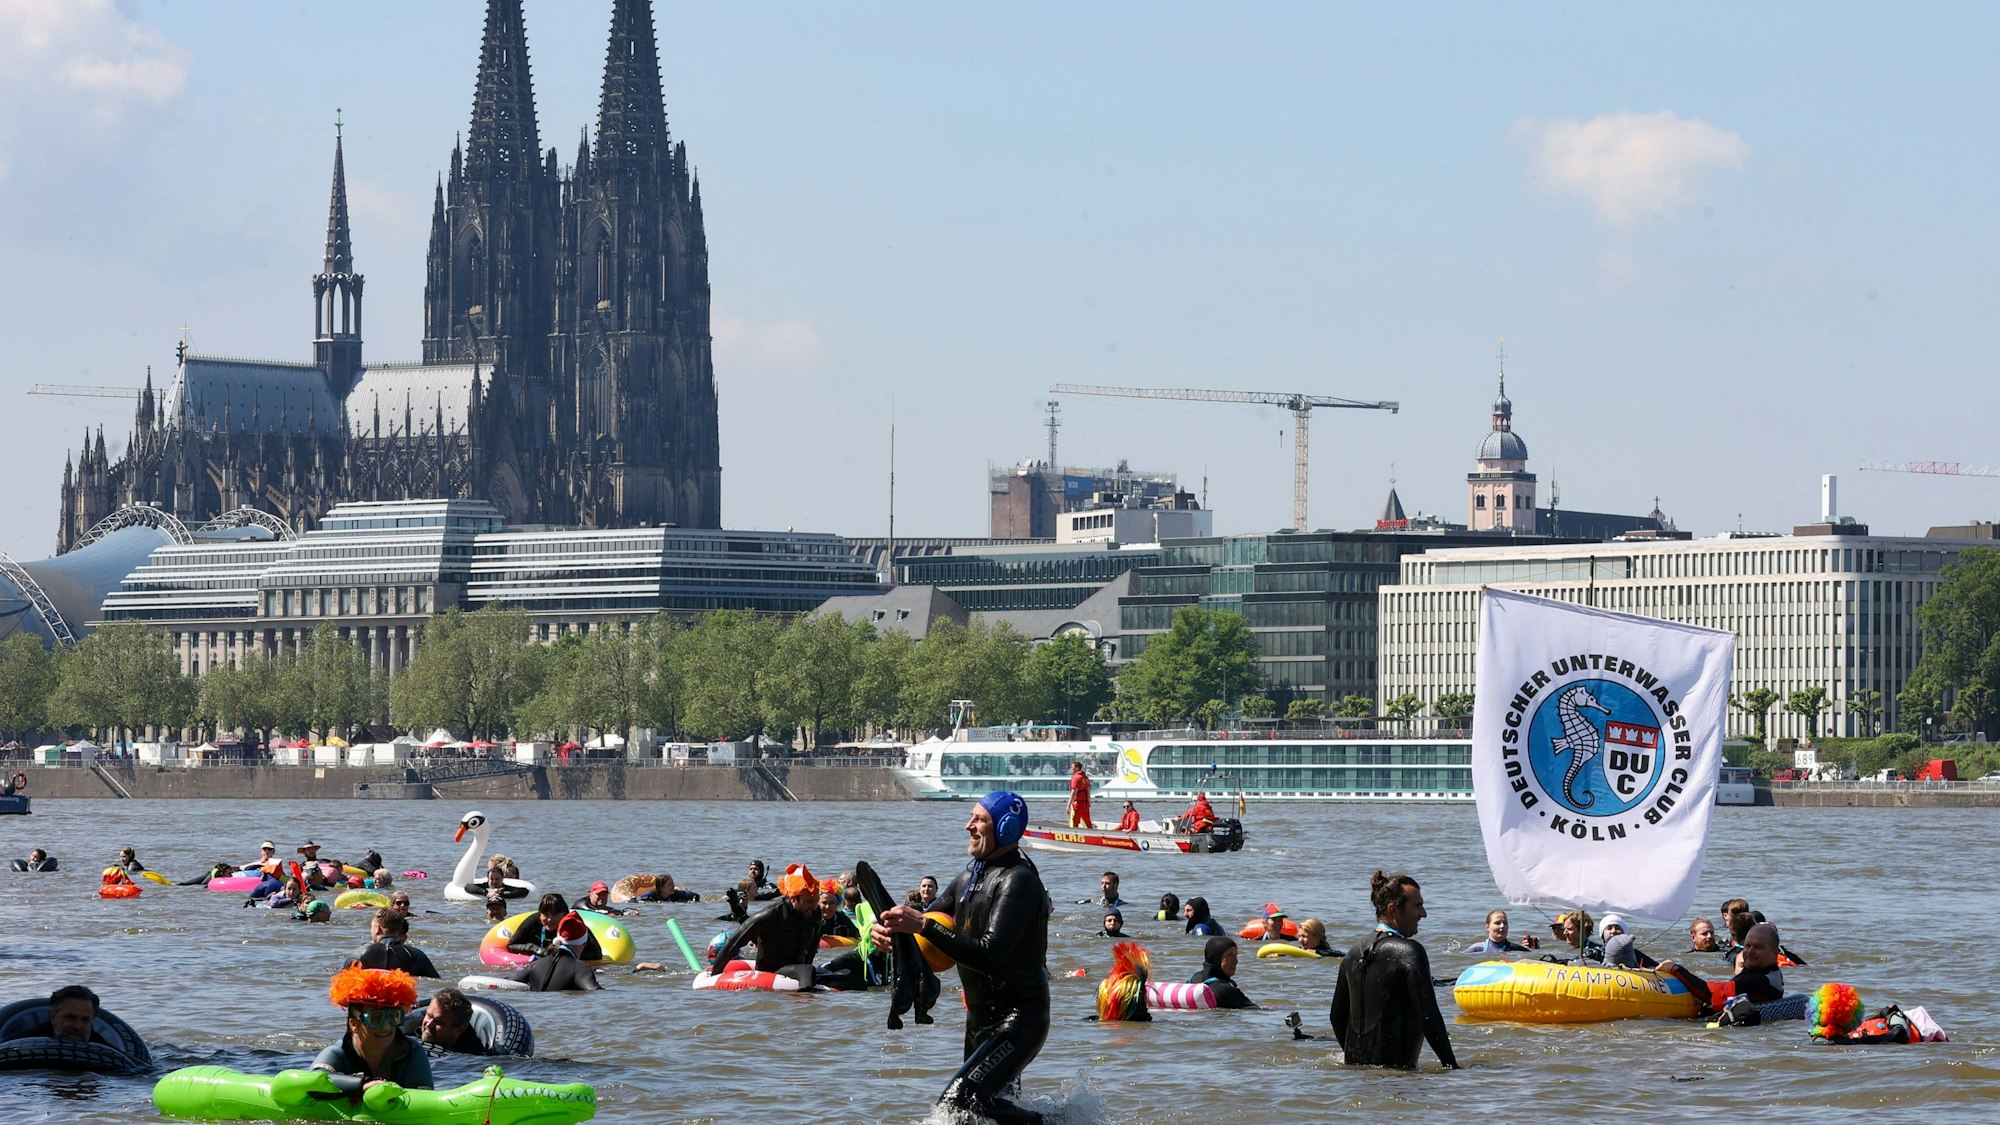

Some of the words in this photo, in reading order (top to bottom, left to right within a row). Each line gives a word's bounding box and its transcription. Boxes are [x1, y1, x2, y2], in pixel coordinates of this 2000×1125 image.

[1502, 670, 1551, 810] DEUTSCHER
[1552, 654, 1691, 761] UNTERWASSER
[1644, 768, 1688, 825] CLUB
[1609, 749, 1650, 774] DU
[1797, 753, 1813, 765] 689
[1616, 774, 1636, 794] C
[1009, 798, 1023, 815] 3
[1055, 832, 1086, 843] DLRG
[1550, 814, 1627, 841] KÖLN
[1546, 967, 1667, 994] TRAMPOLINE
[977, 1040, 1016, 1076] MYSTIC
